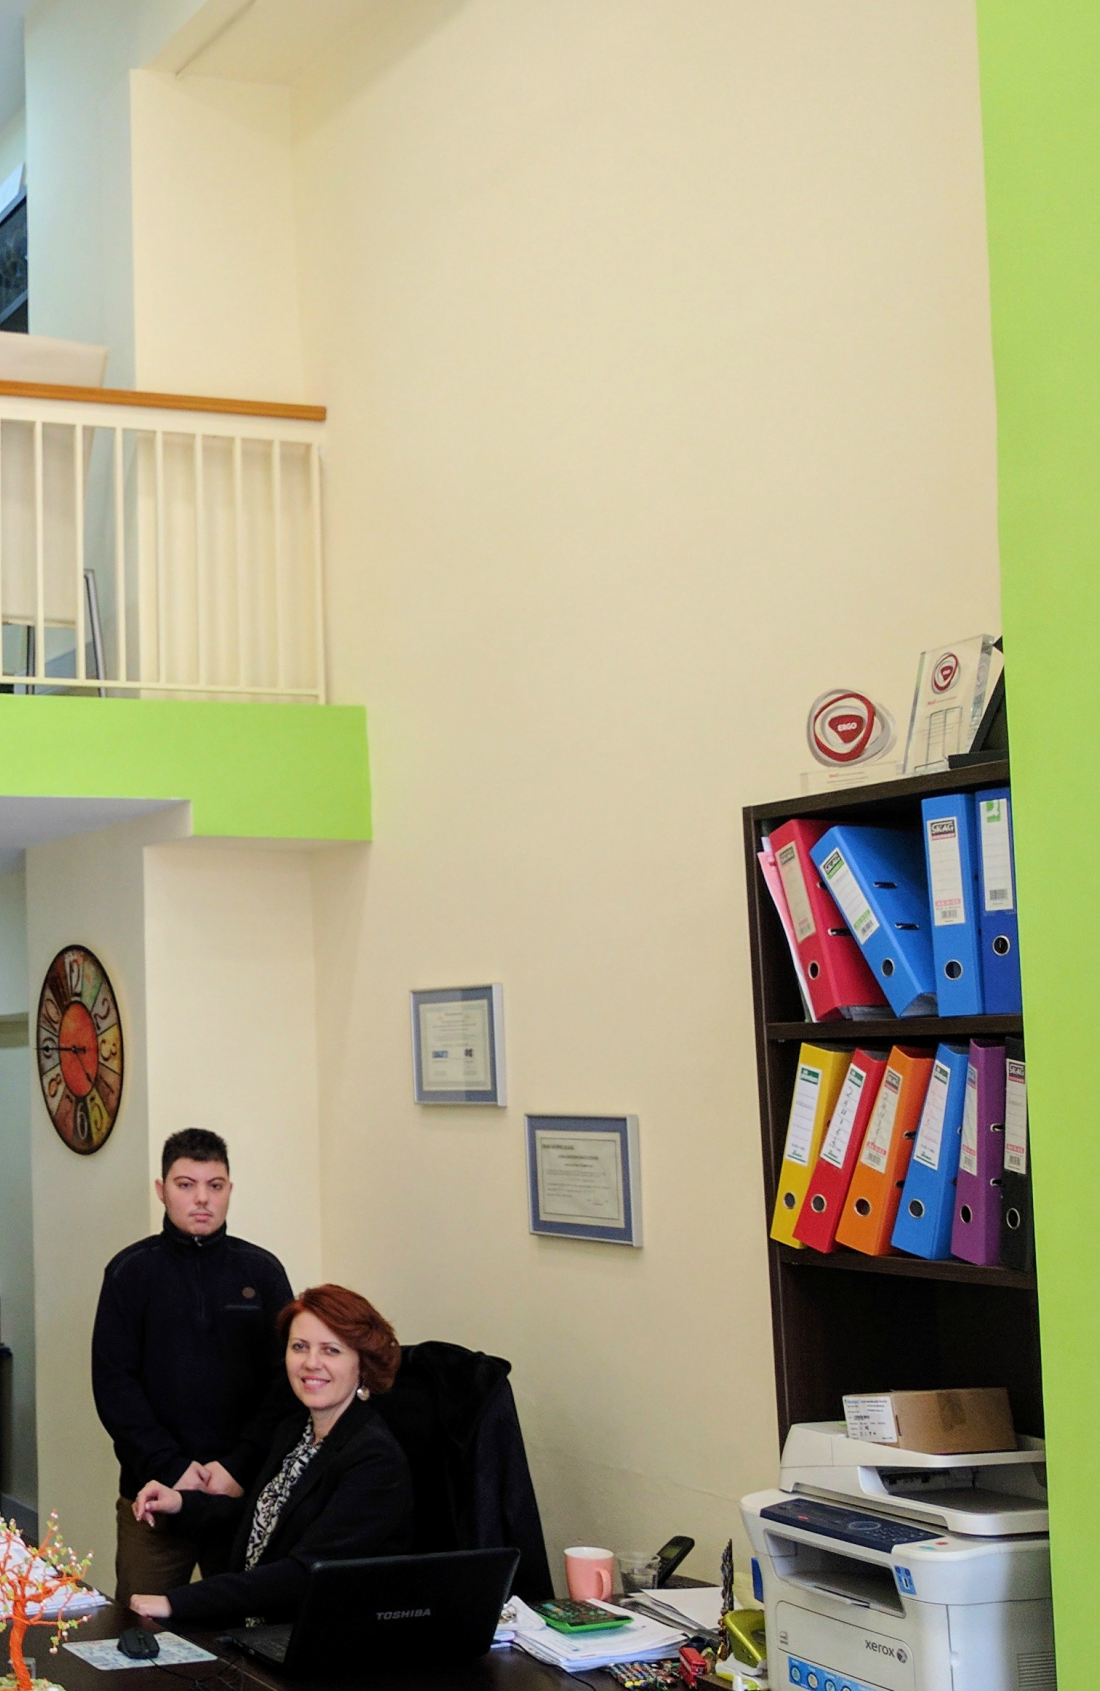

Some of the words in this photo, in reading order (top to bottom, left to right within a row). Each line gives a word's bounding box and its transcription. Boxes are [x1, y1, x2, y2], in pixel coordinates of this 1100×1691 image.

[837, 722, 858, 732] ERGO
[931, 821, 955, 835] SKAG
[375, 1608, 431, 1620] TOSHIBA
[865, 1640, 896, 1658] xerox
